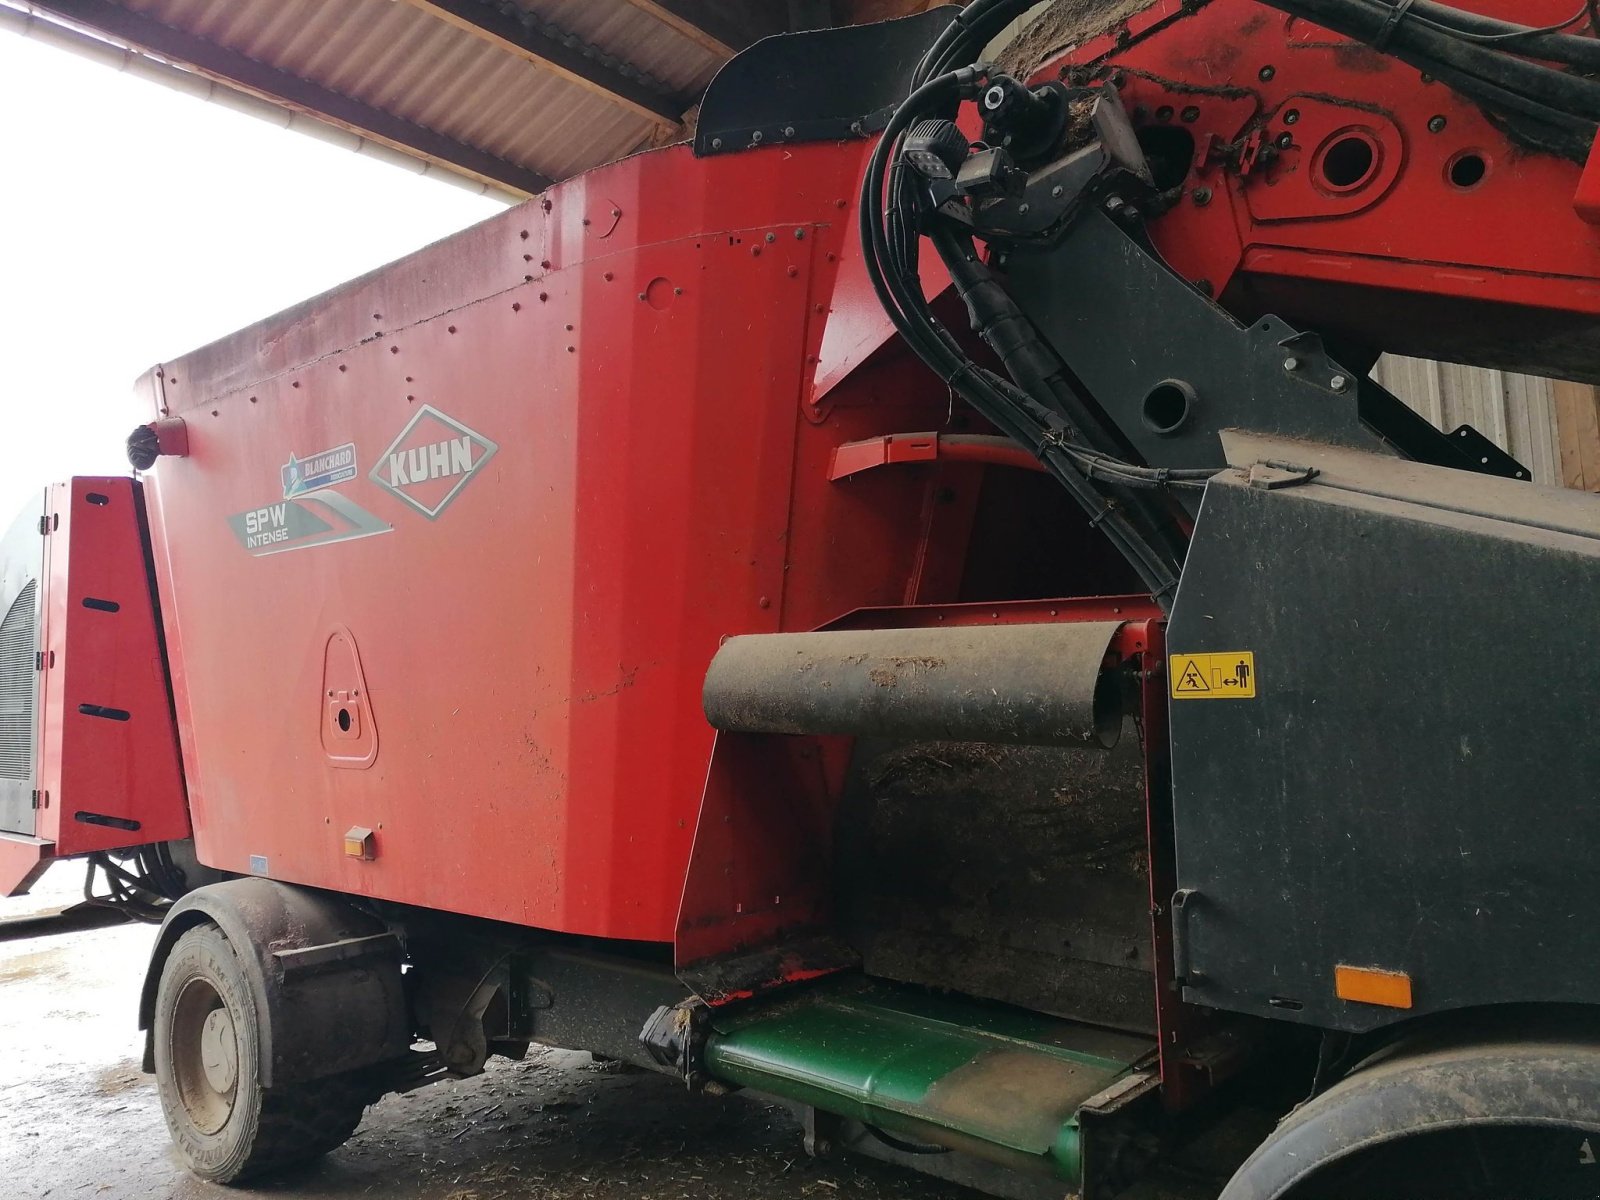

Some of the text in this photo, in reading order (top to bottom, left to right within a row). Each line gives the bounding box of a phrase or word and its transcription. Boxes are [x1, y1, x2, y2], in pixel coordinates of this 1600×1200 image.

[304, 450, 351, 477] BLANCHARD
[389, 435, 472, 488] KUHN
[246, 503, 286, 534] SPW
[247, 527, 289, 549] INTENSE
